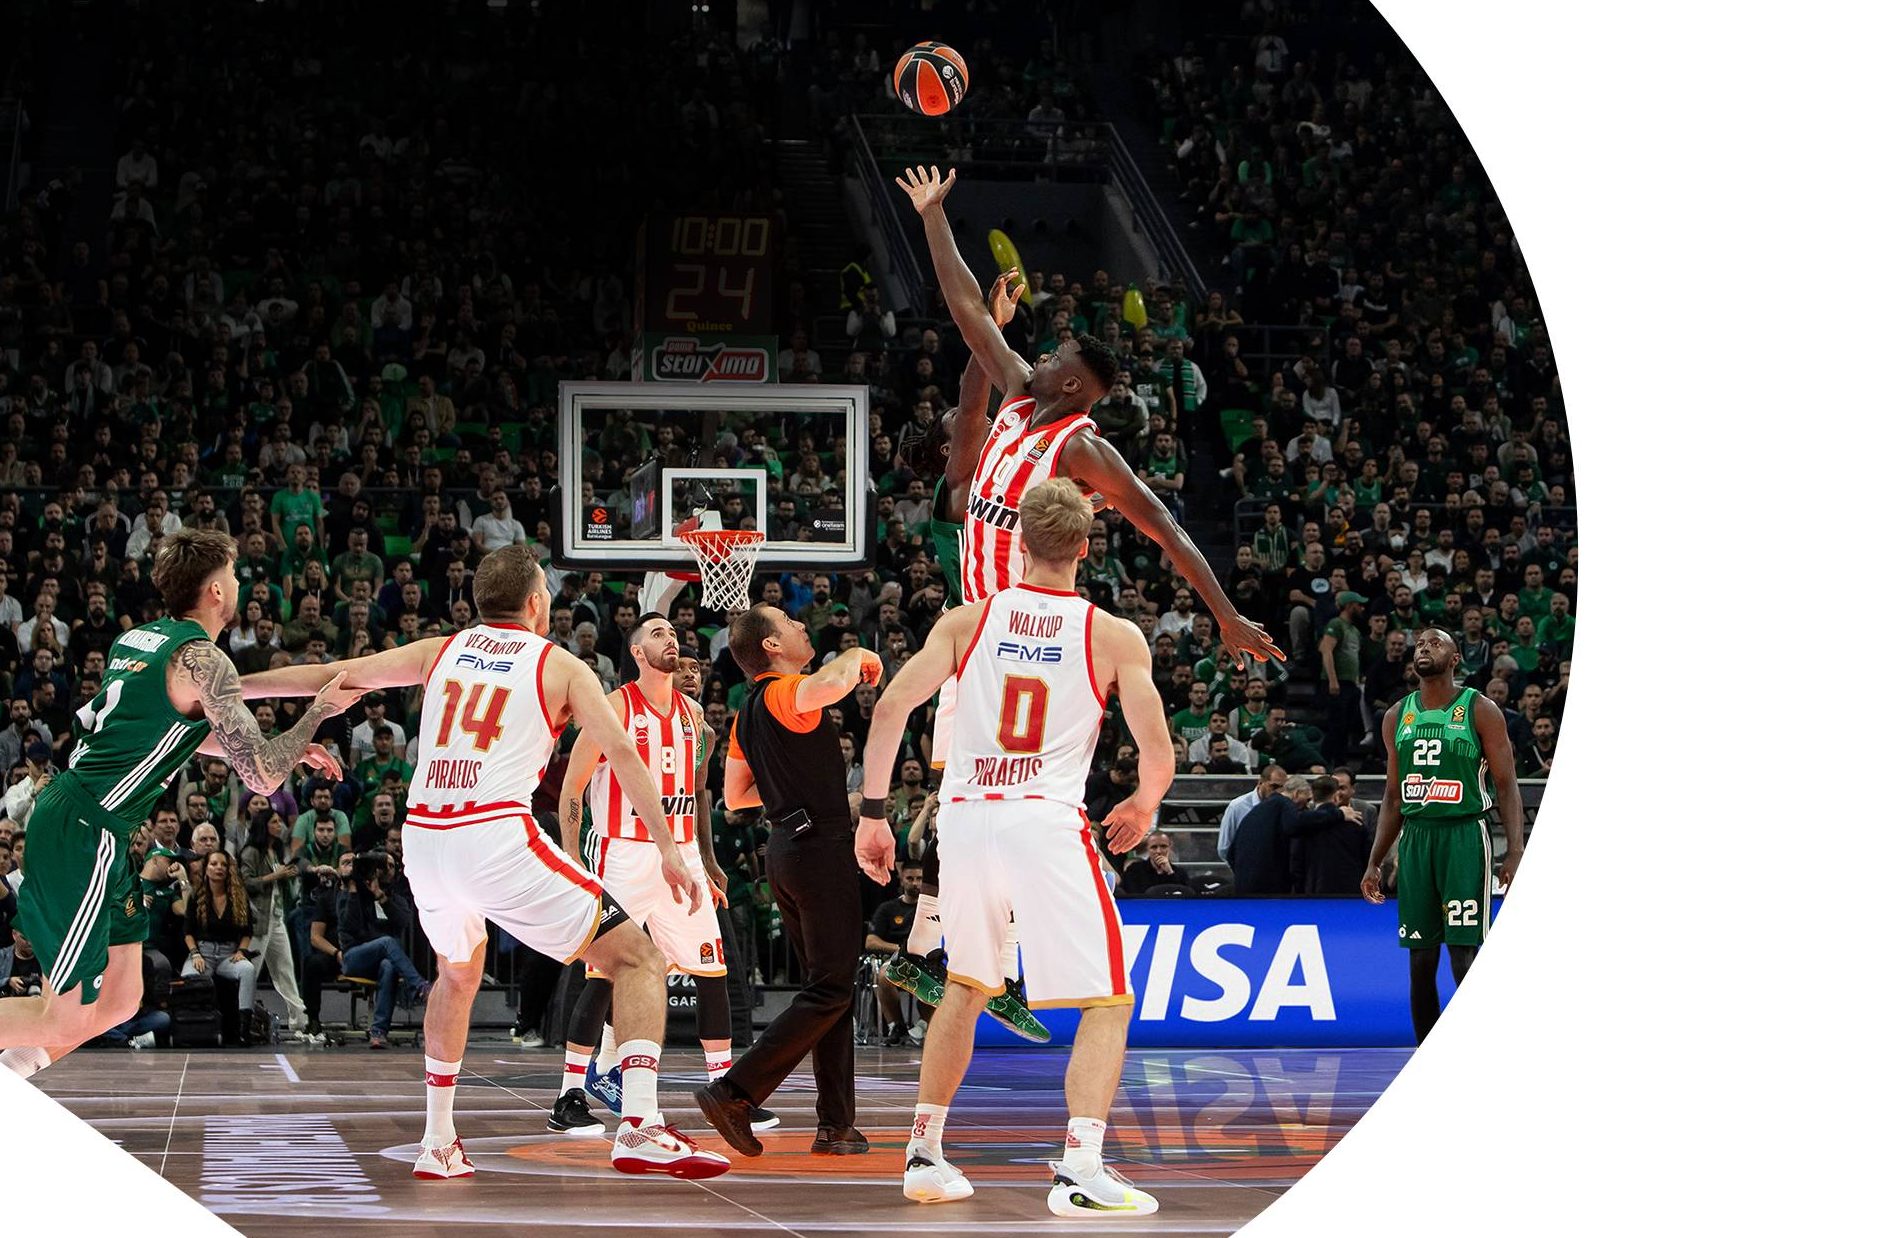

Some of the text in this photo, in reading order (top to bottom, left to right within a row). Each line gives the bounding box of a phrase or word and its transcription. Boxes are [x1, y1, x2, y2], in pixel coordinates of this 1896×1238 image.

[671, 216, 769, 256] 10:00
[665, 264, 755, 320] 24
[968, 493, 1020, 531] win
[1008, 610, 1063, 638] WALKUP
[464, 633, 527, 655] VEZENKOV
[997, 642, 1062, 662] FMS
[456, 654, 514, 673] FMS
[435, 678, 512, 753] 14
[996, 673, 1050, 754] 0
[661, 746, 676, 774] 8
[1413, 739, 1441, 766] 22
[425, 759, 482, 789] PIRAEUS
[1447, 899, 1478, 926] 22
